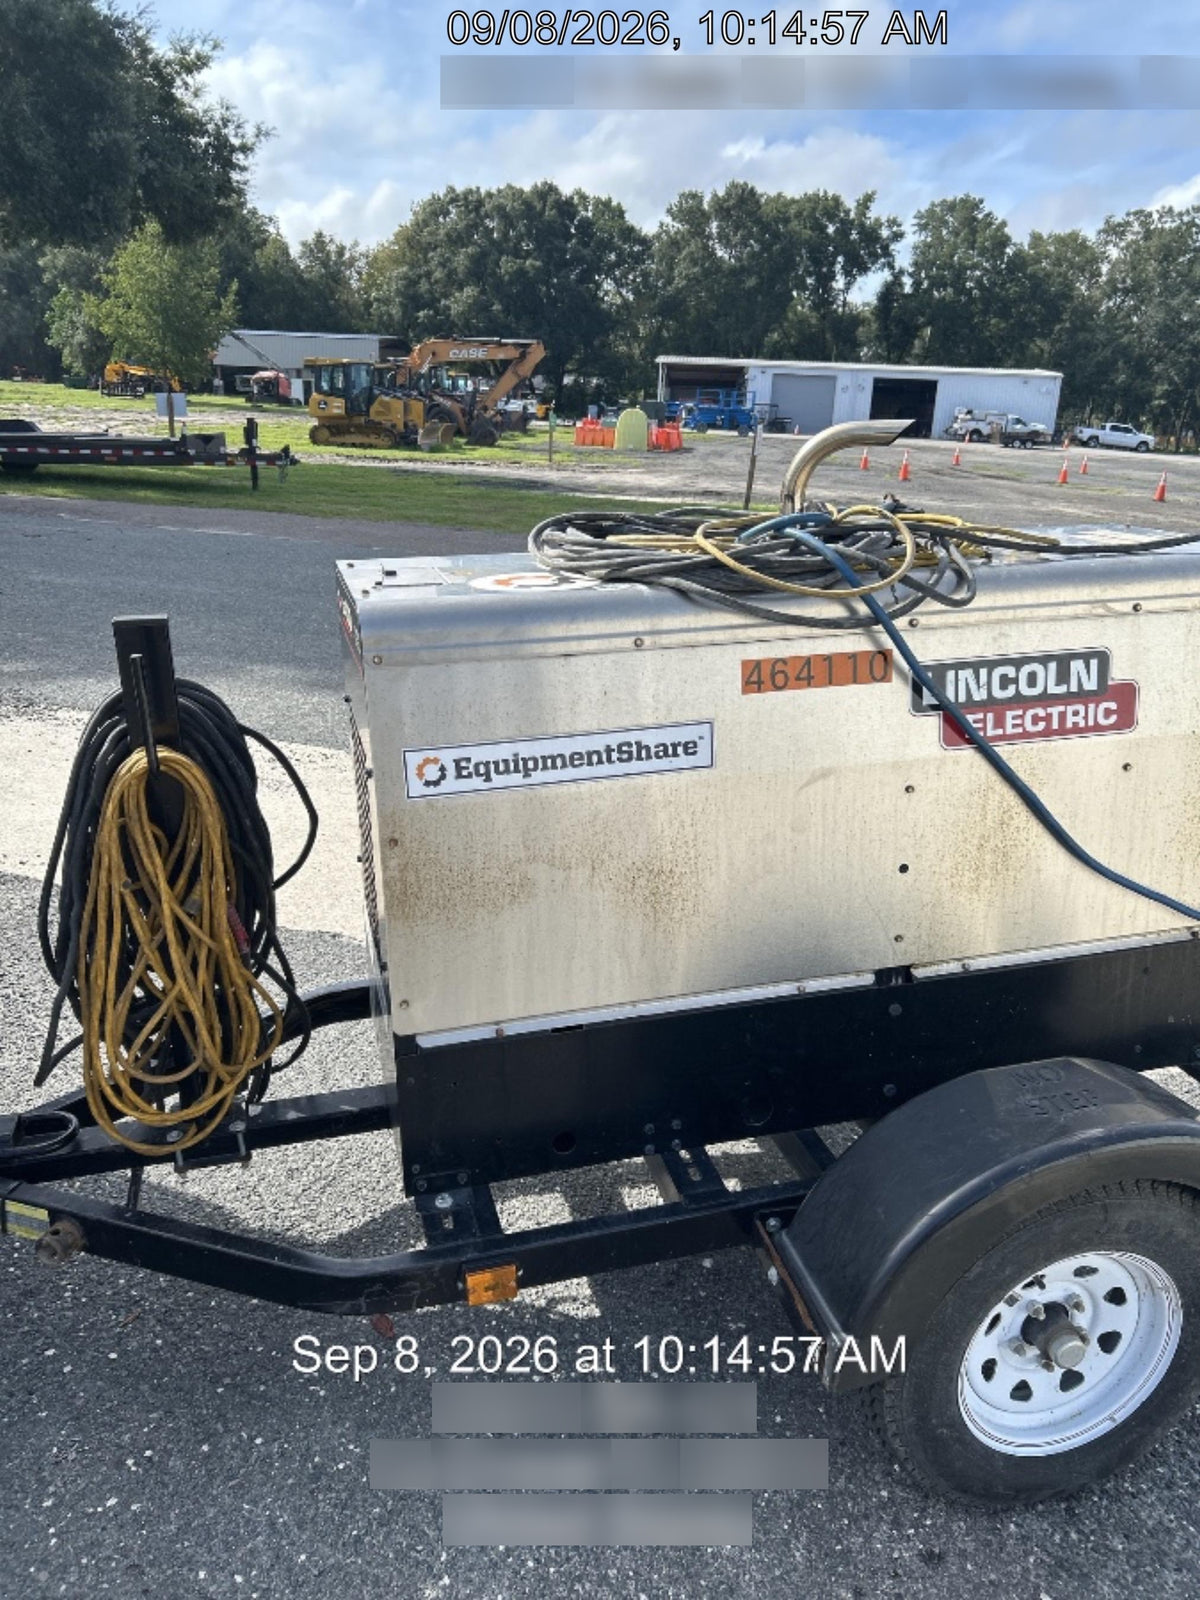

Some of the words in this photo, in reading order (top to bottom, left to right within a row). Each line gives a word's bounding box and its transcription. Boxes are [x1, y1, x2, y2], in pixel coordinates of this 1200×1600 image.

[449, 348, 488, 358] CASE
[745, 650, 888, 692] 464110
[922, 658, 1098, 706] LINCOLN
[964, 701, 1118, 738] ELECTRIC
